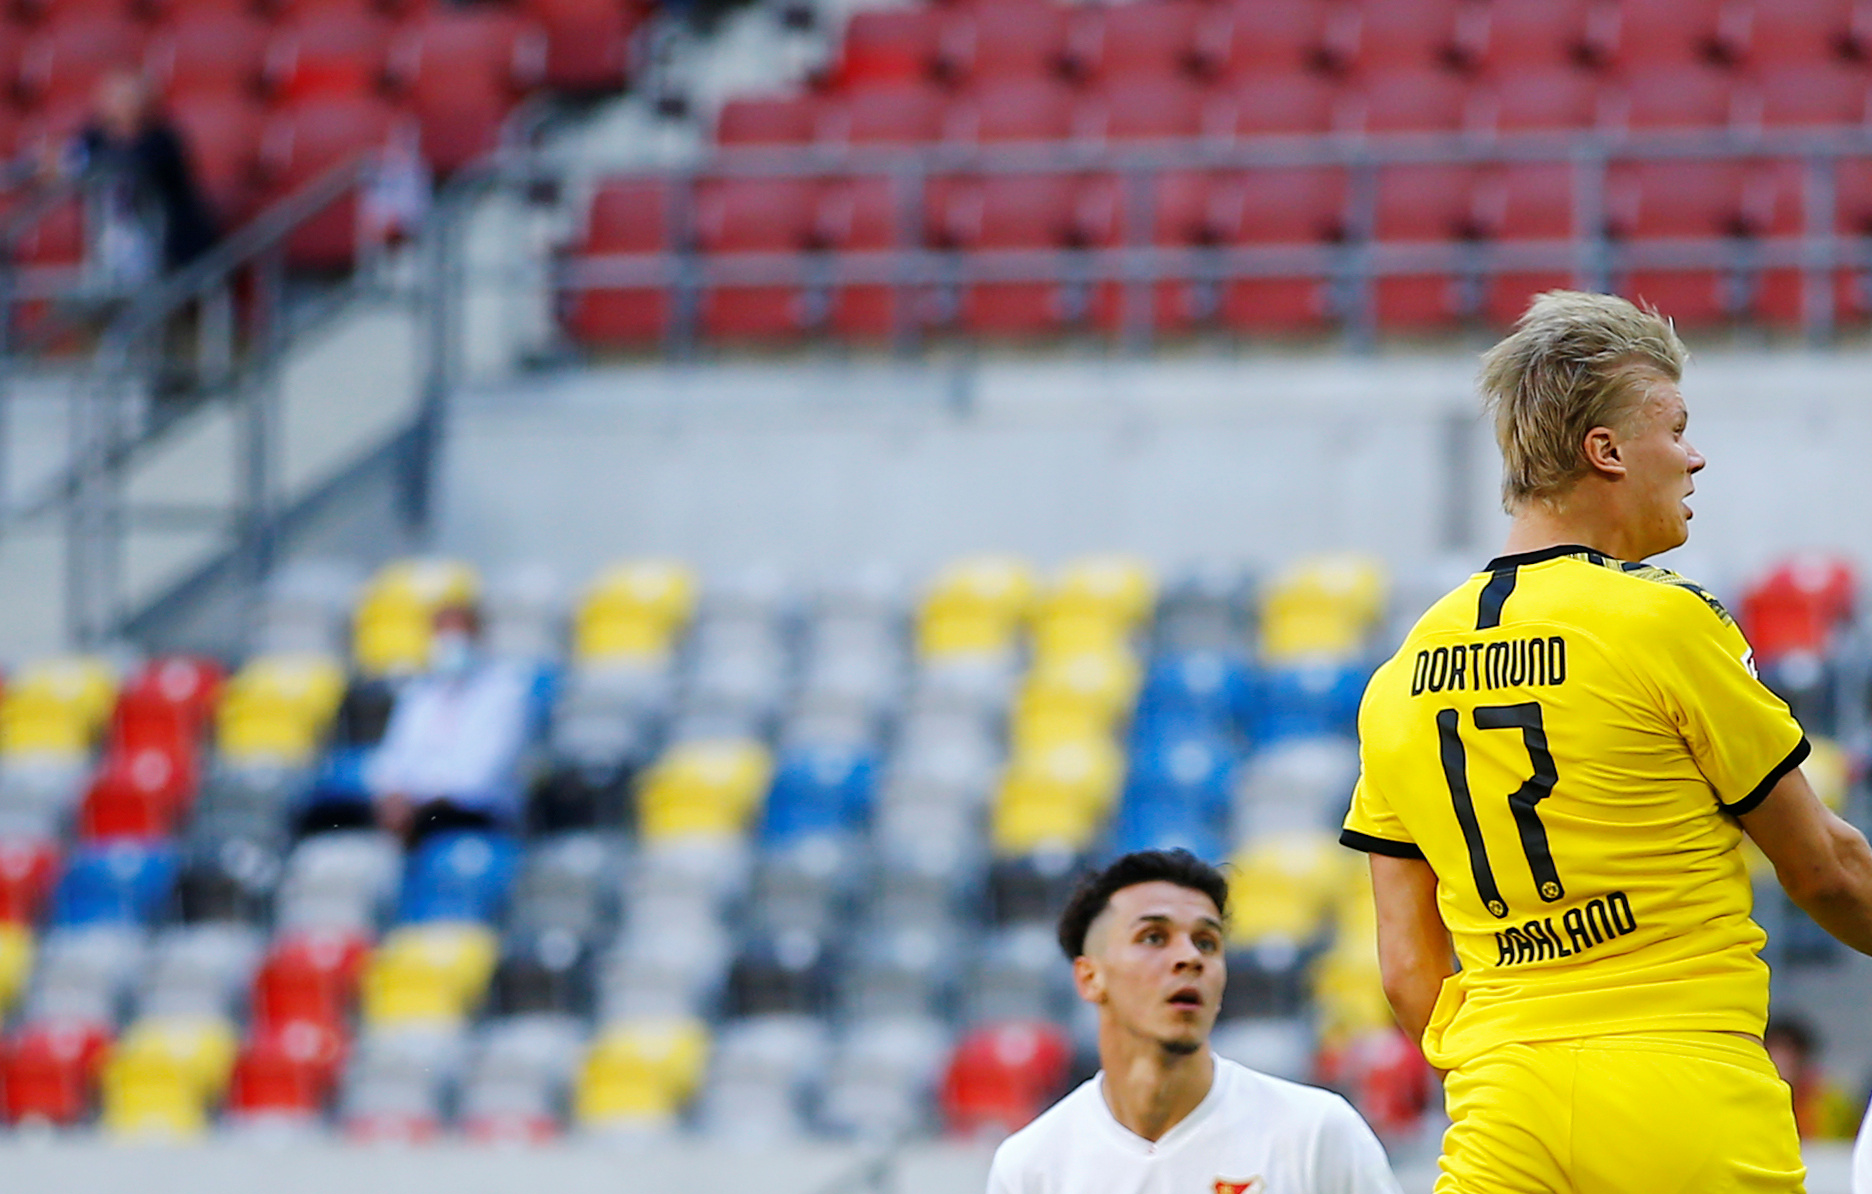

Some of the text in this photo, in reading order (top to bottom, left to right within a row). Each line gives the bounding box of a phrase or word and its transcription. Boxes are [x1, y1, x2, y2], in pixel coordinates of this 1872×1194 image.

[1411, 636, 1566, 696] DORTMUND
[1436, 701, 1565, 918] 17
[1495, 890, 1637, 967] HAALAND
